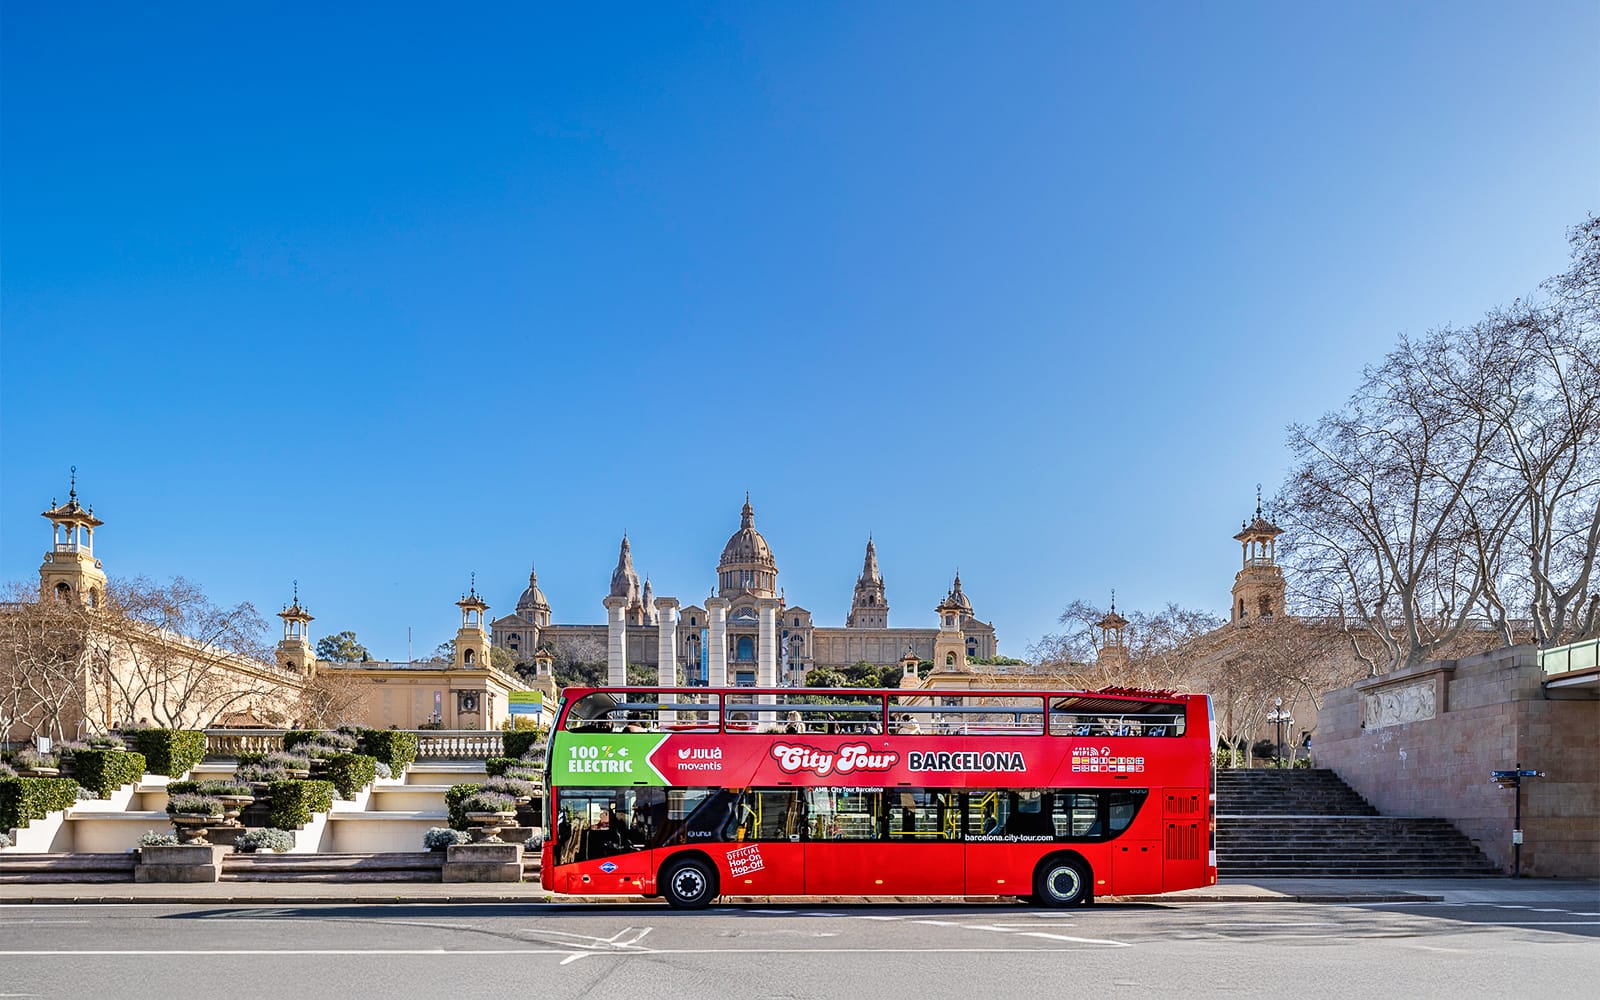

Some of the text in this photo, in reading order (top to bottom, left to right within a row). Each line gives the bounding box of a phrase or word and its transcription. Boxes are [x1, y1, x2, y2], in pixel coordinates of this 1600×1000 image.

[678, 761, 722, 771] moventis
[773, 745, 896, 773] City Tour
[908, 751, 1027, 772] BARCELONA
[568, 760, 633, 773] ELECTRIC
[964, 834, 1054, 843] barcelona.city-tour.com
[726, 846, 760, 860] OFFICIAL
[728, 854, 761, 868] Hop-On
[730, 860, 764, 875] Hop-Off
